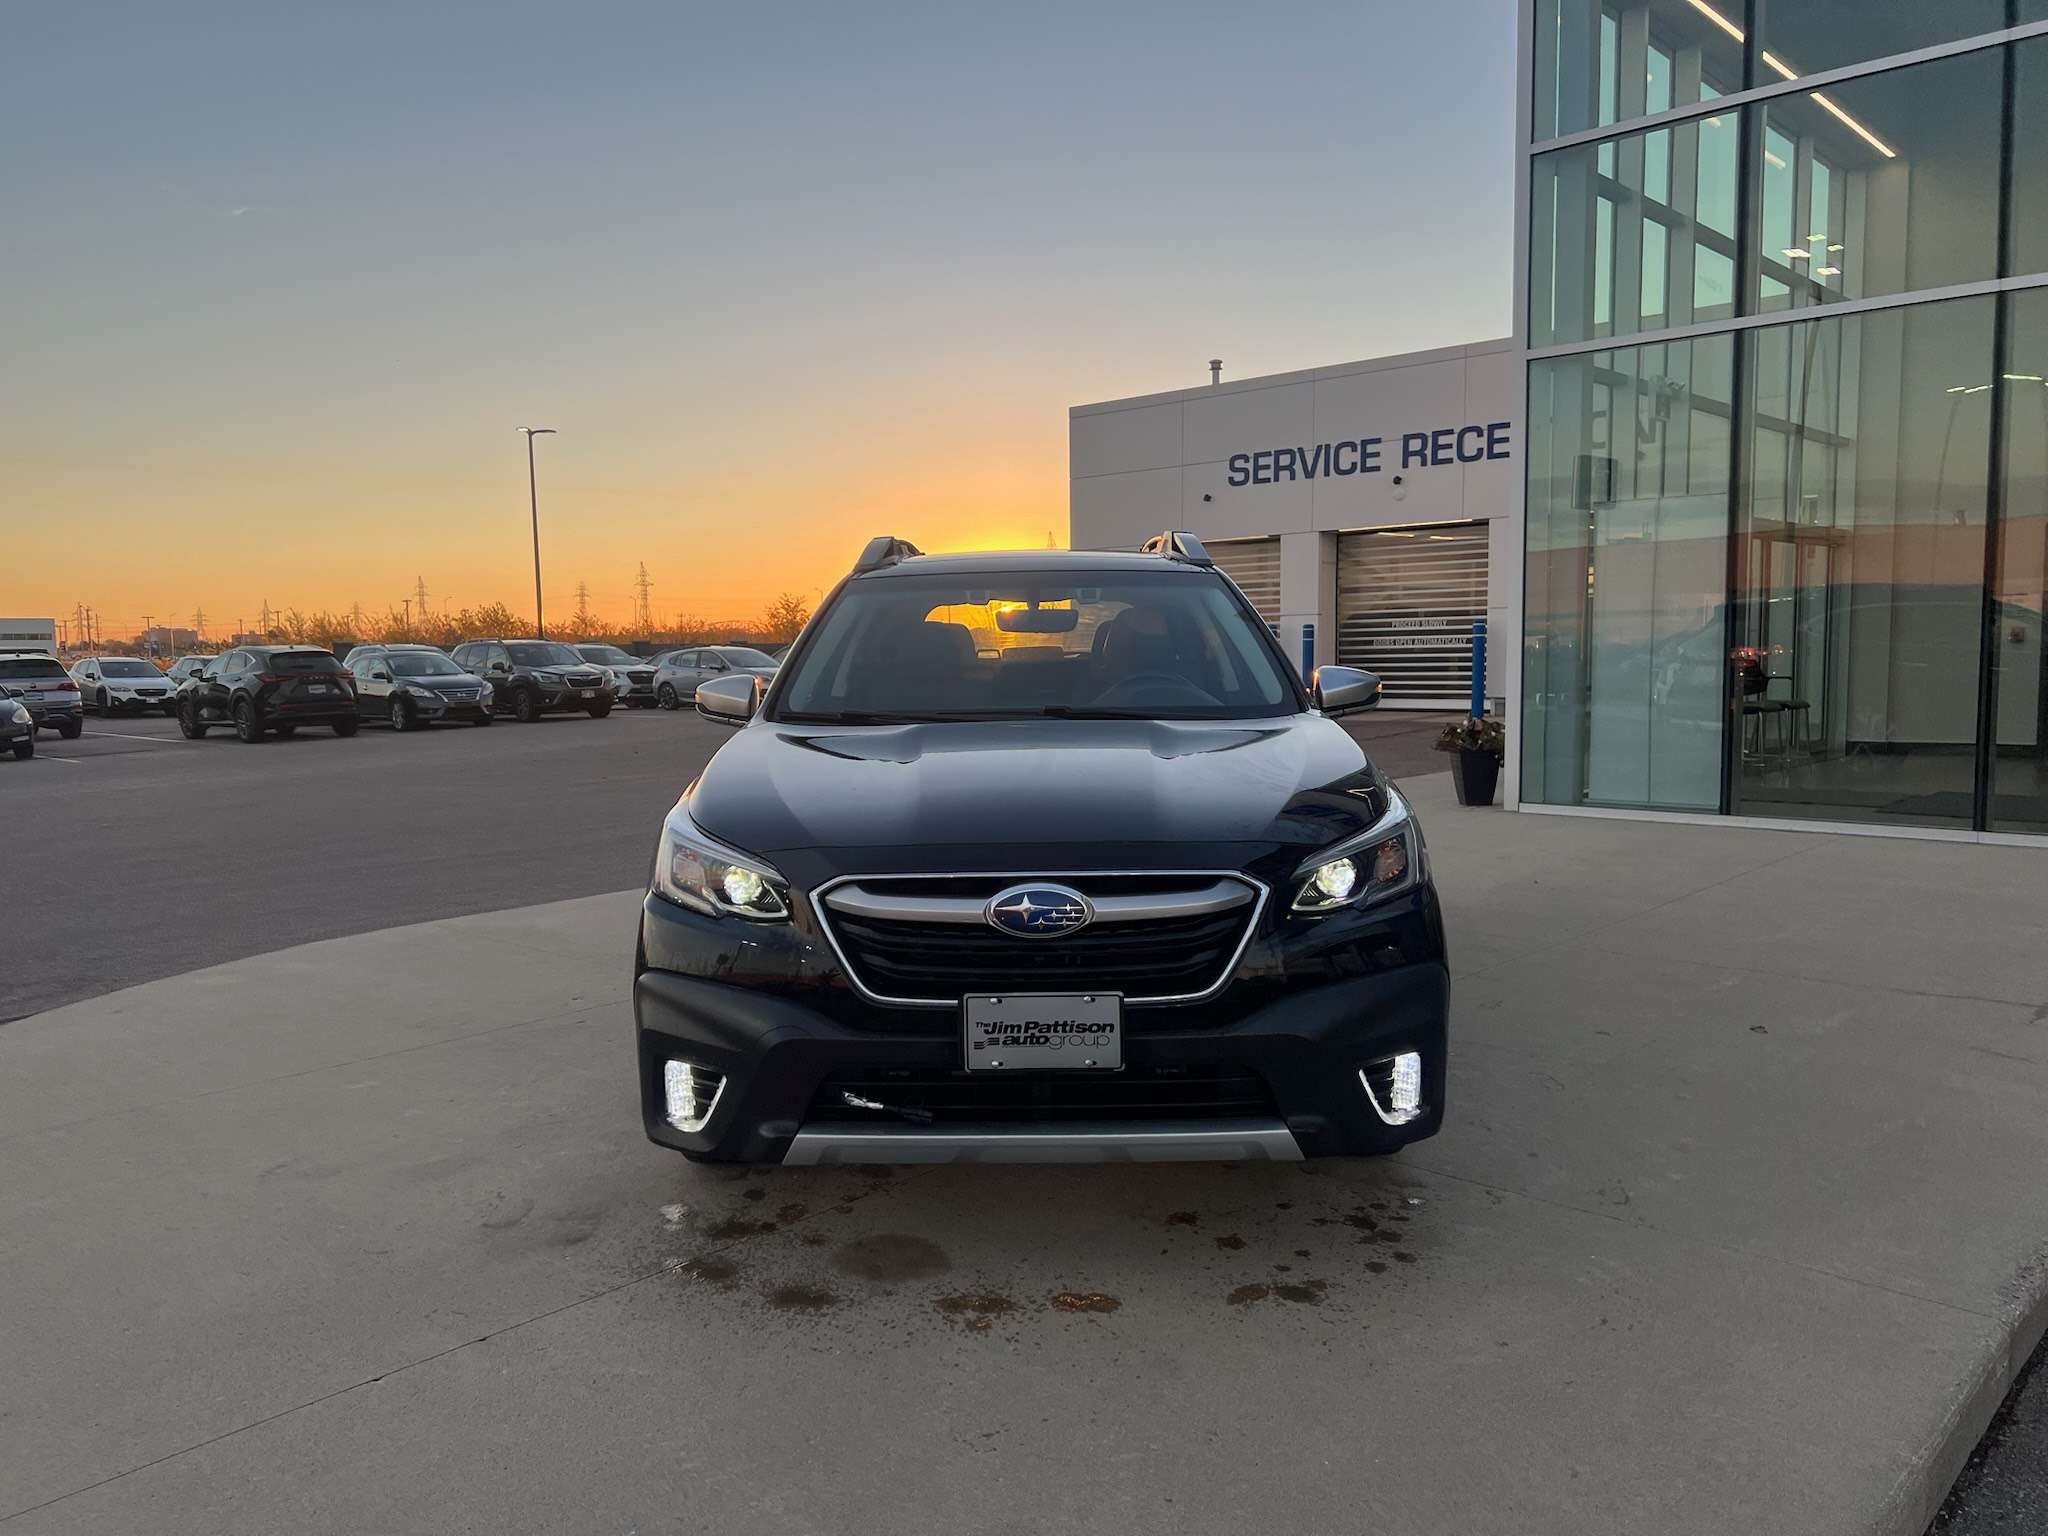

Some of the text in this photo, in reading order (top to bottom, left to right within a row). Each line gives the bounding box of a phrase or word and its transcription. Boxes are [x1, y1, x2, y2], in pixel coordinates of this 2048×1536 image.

[1228, 422, 1511, 487] SERVICE RECE
[1396, 638, 1413, 647] OPEN
[1414, 637, 1468, 646] AUTOMATICALLY
[976, 1021, 991, 1029] The
